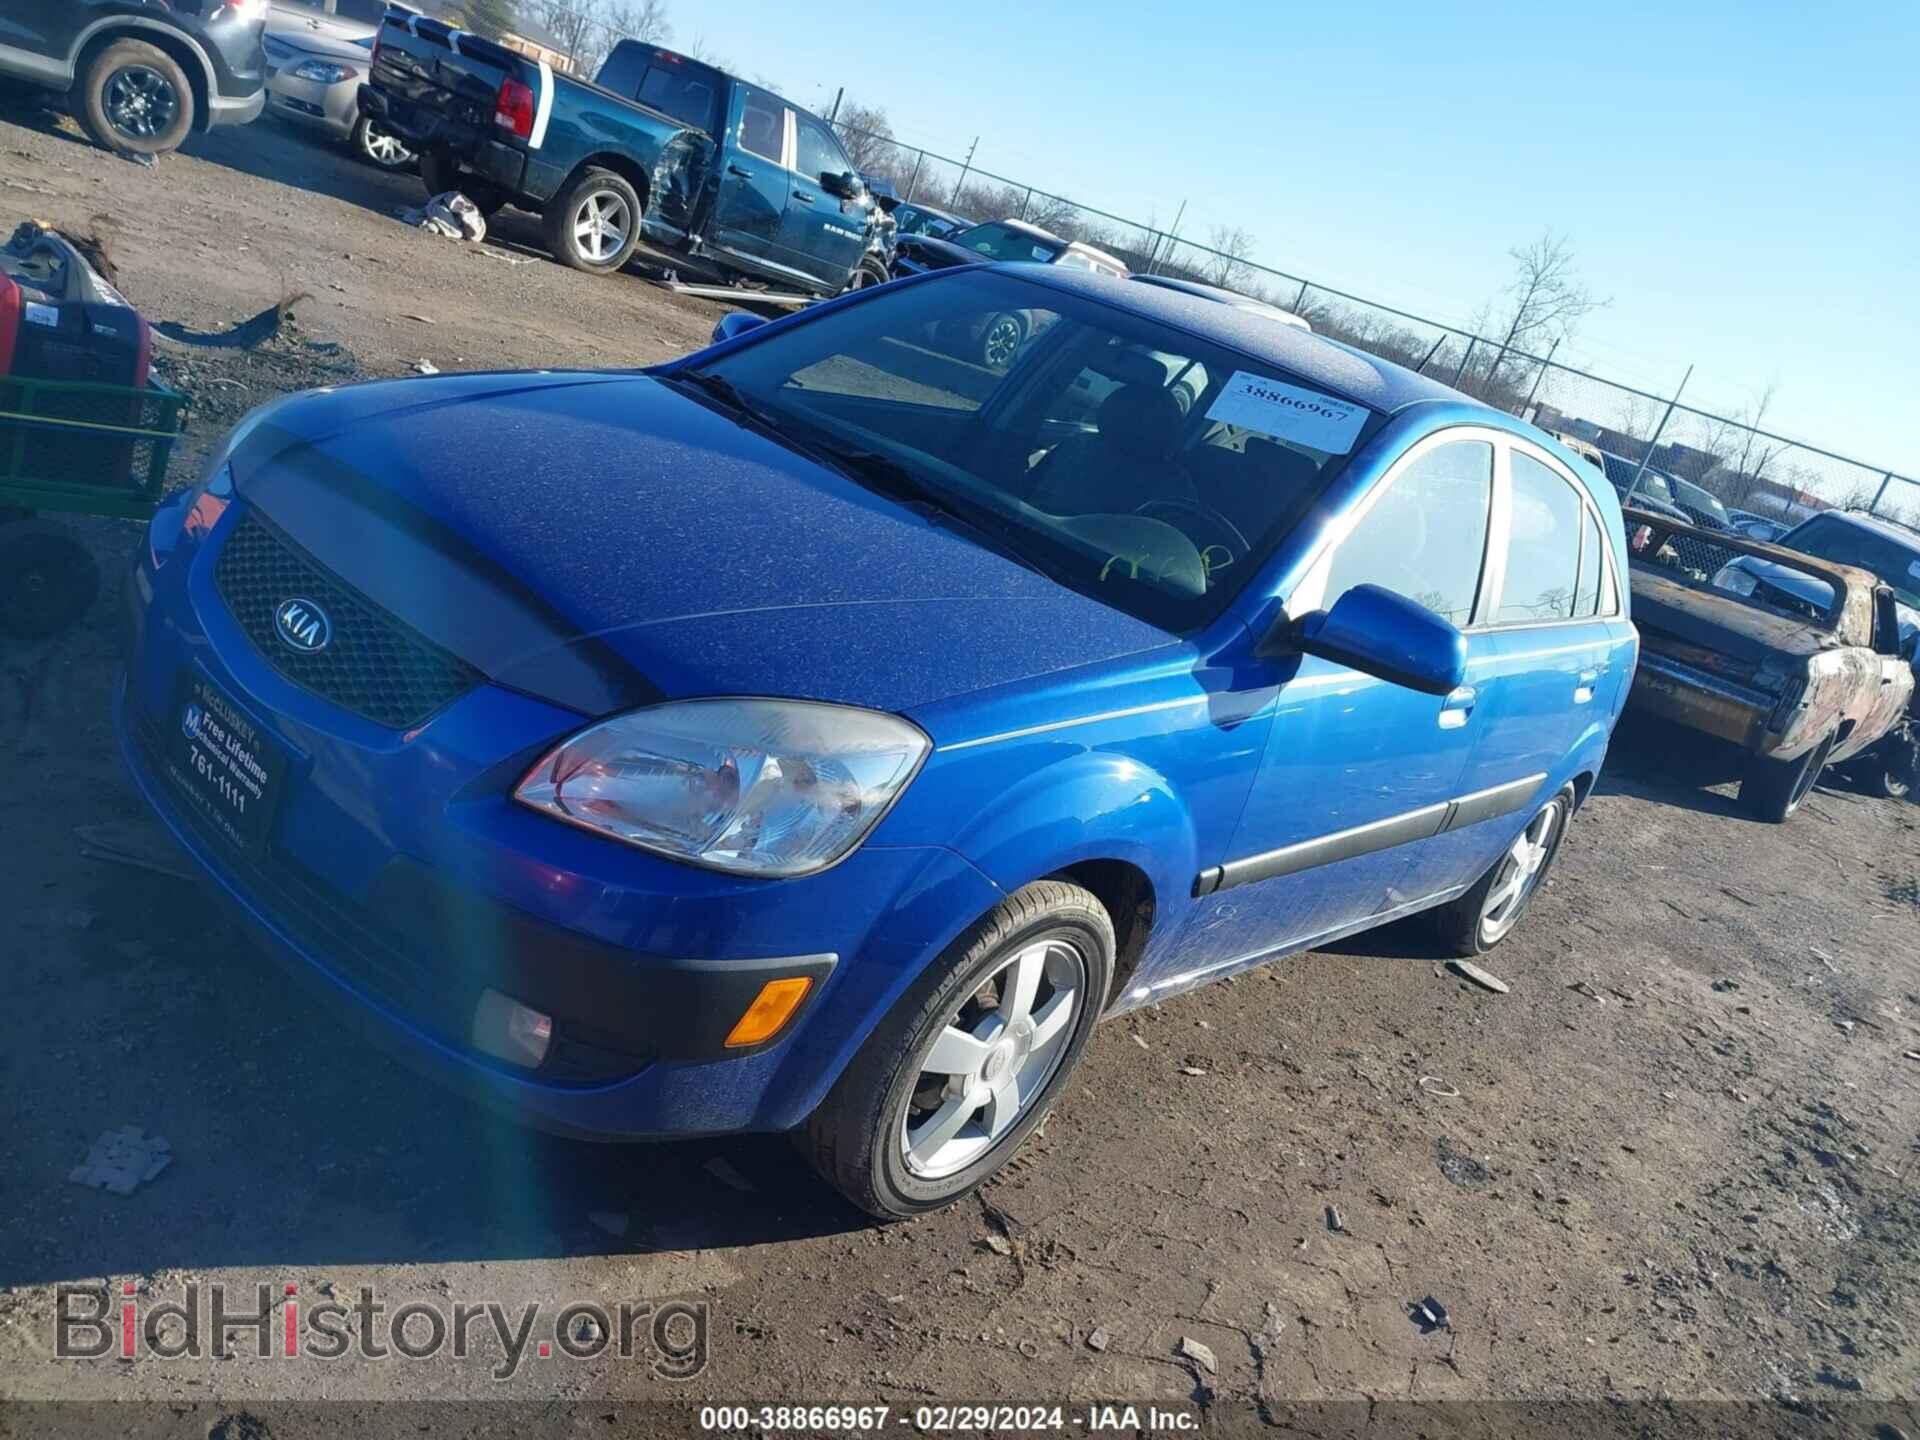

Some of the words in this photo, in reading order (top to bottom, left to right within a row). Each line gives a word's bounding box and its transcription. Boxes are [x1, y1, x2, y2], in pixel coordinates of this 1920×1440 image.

[1239, 384, 1349, 422] 38866967
[283, 604, 320, 646] KIA
[202, 711, 225, 742] Free
[225, 734, 268, 784] Lifetime
[190, 745, 246, 813] 761-1111
[228, 759, 264, 800] Warranty
